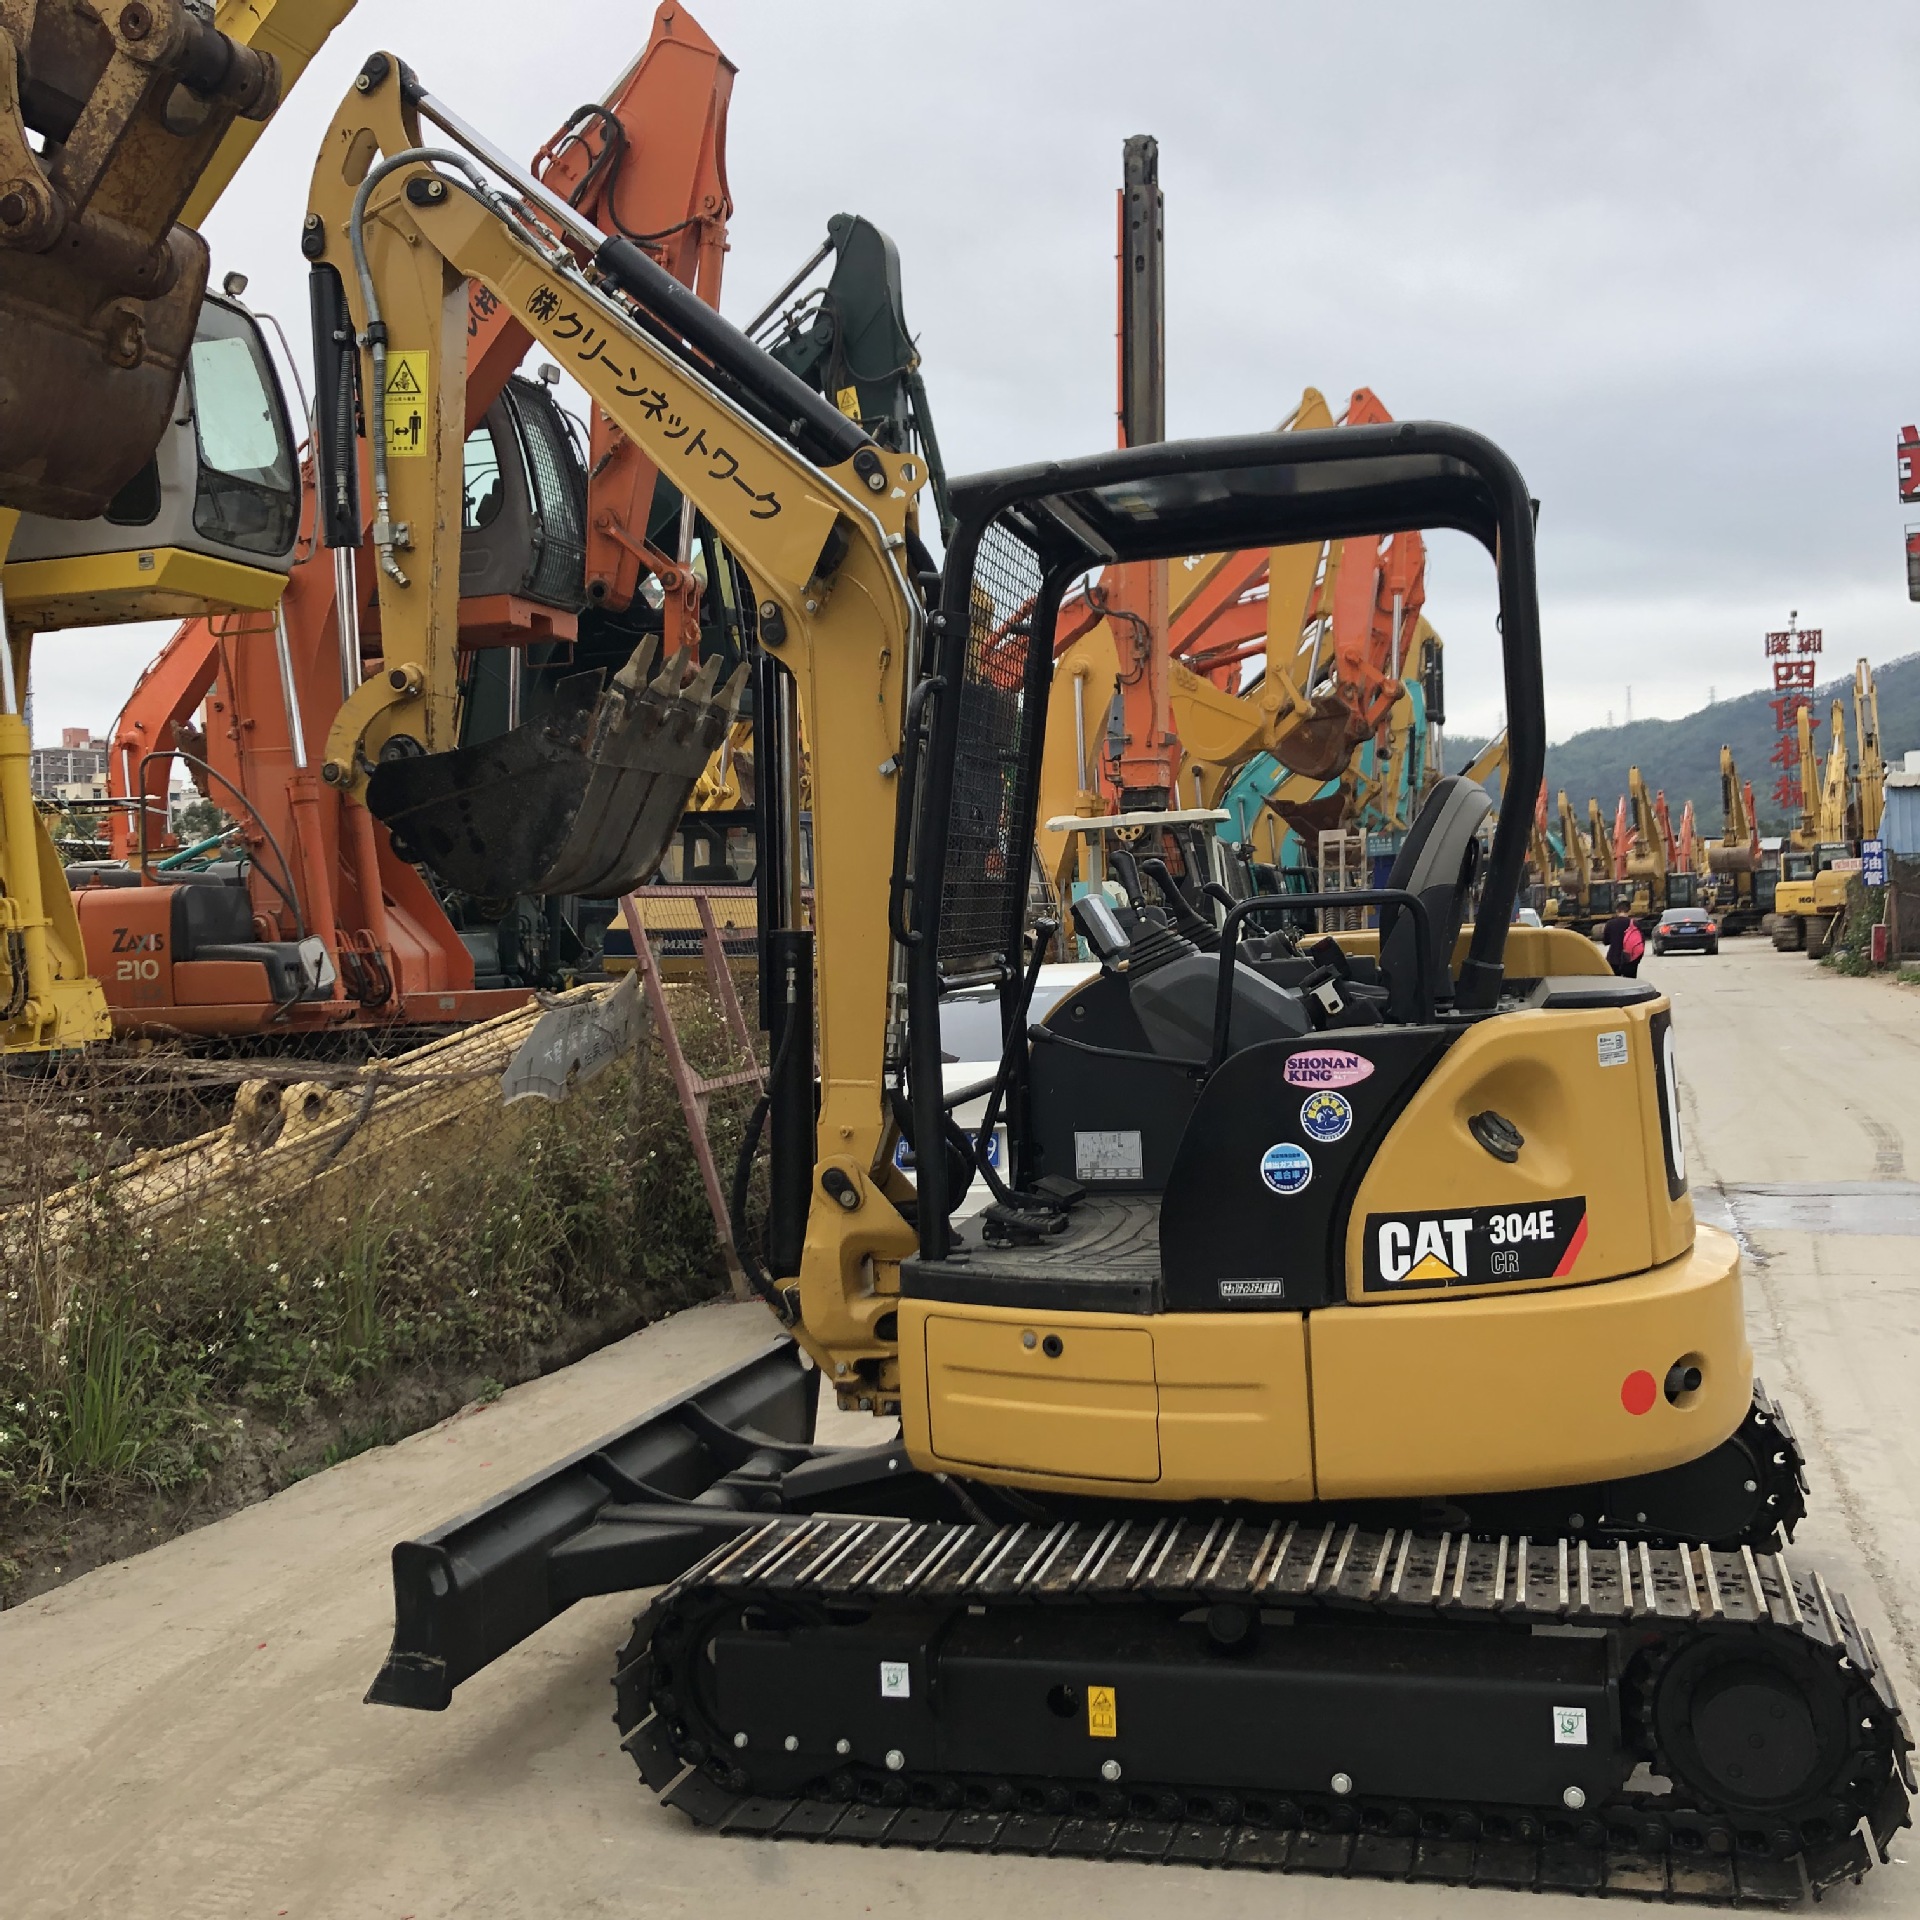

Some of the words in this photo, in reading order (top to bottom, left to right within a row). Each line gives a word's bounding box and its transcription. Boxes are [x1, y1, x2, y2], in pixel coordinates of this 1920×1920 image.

[112, 928, 164, 956] ZAXIS
[117, 959, 159, 981] 210
[1287, 1057, 1359, 1070] SHONAN
[1288, 1070, 1333, 1082] KING
[1378, 1218, 1472, 1282] CAT
[1489, 1210, 1555, 1244] 304E
[1491, 1250, 1520, 1274] CR
